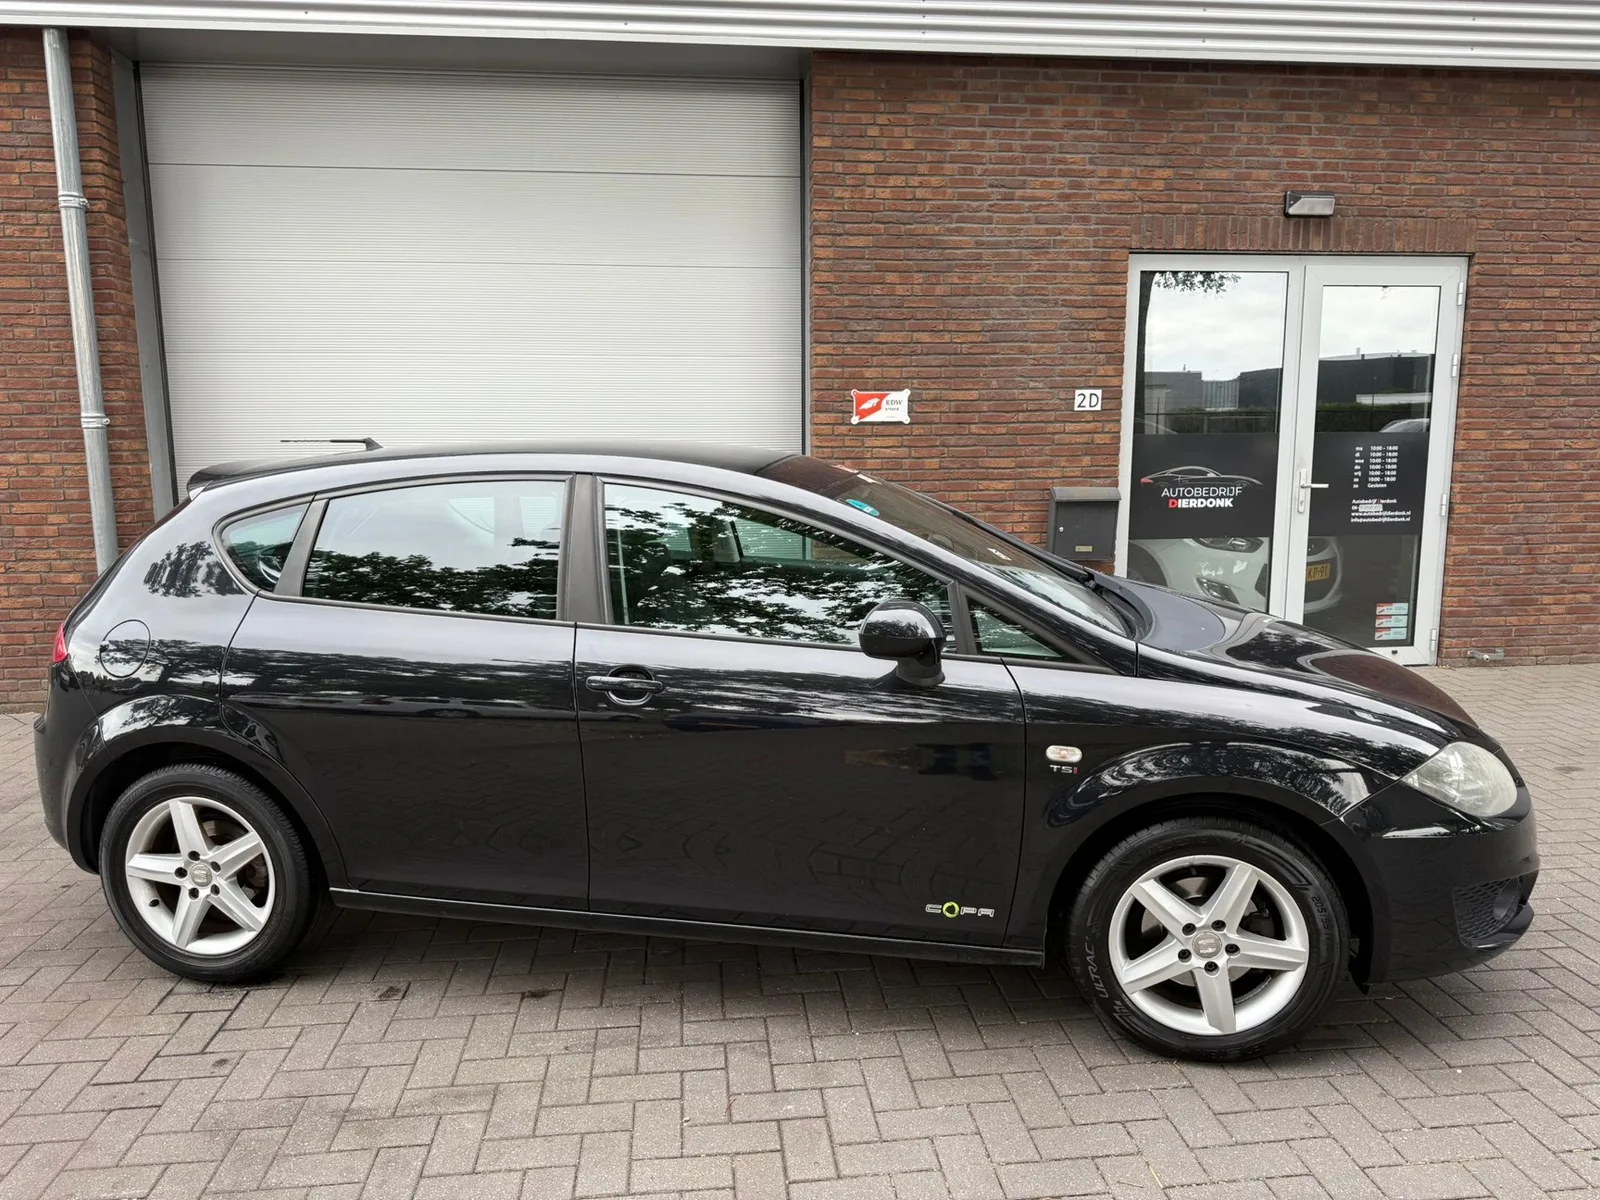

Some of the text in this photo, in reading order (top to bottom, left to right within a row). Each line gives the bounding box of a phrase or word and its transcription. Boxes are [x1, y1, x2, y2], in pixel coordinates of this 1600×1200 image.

[1077, 393, 1099, 408] 2D
[1161, 487, 1242, 497] AUTOBEDRIJF
[1168, 498, 1233, 508] DIERDONK
[1085, 942, 1109, 998] ULTRAC
